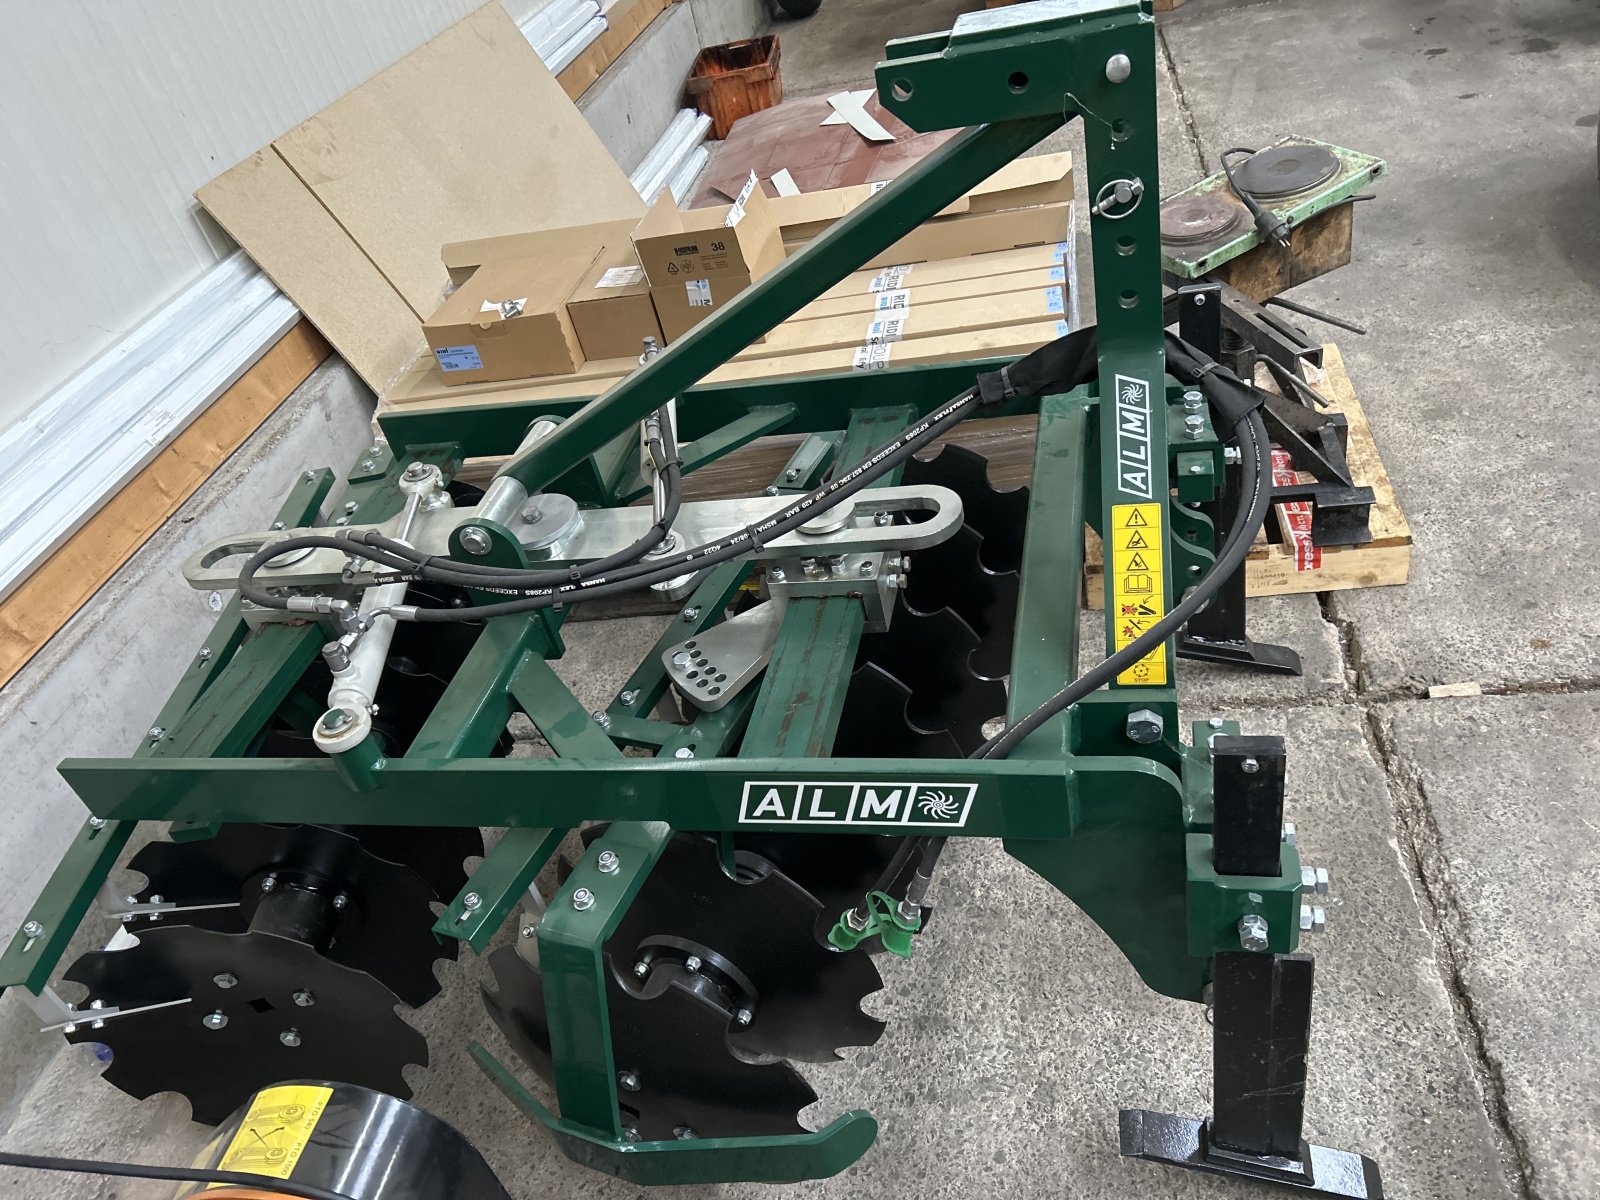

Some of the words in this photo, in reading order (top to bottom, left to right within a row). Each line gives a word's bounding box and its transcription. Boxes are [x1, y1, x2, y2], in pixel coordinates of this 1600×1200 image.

[711, 242, 725, 251] 38
[872, 441, 901, 464] EXCEEDS
[1122, 410, 1147, 491] ALM
[861, 461, 872, 471] EN
[815, 491, 826, 501] WP
[801, 499, 813, 509] 420
[784, 506, 800, 518] BAR
[757, 519, 777, 533] MSHA
[703, 545, 720, 555] 4Q22
[752, 788, 903, 818] ALM
[311, 1101, 323, 1116] PTO
[290, 1142, 302, 1158] PTO
